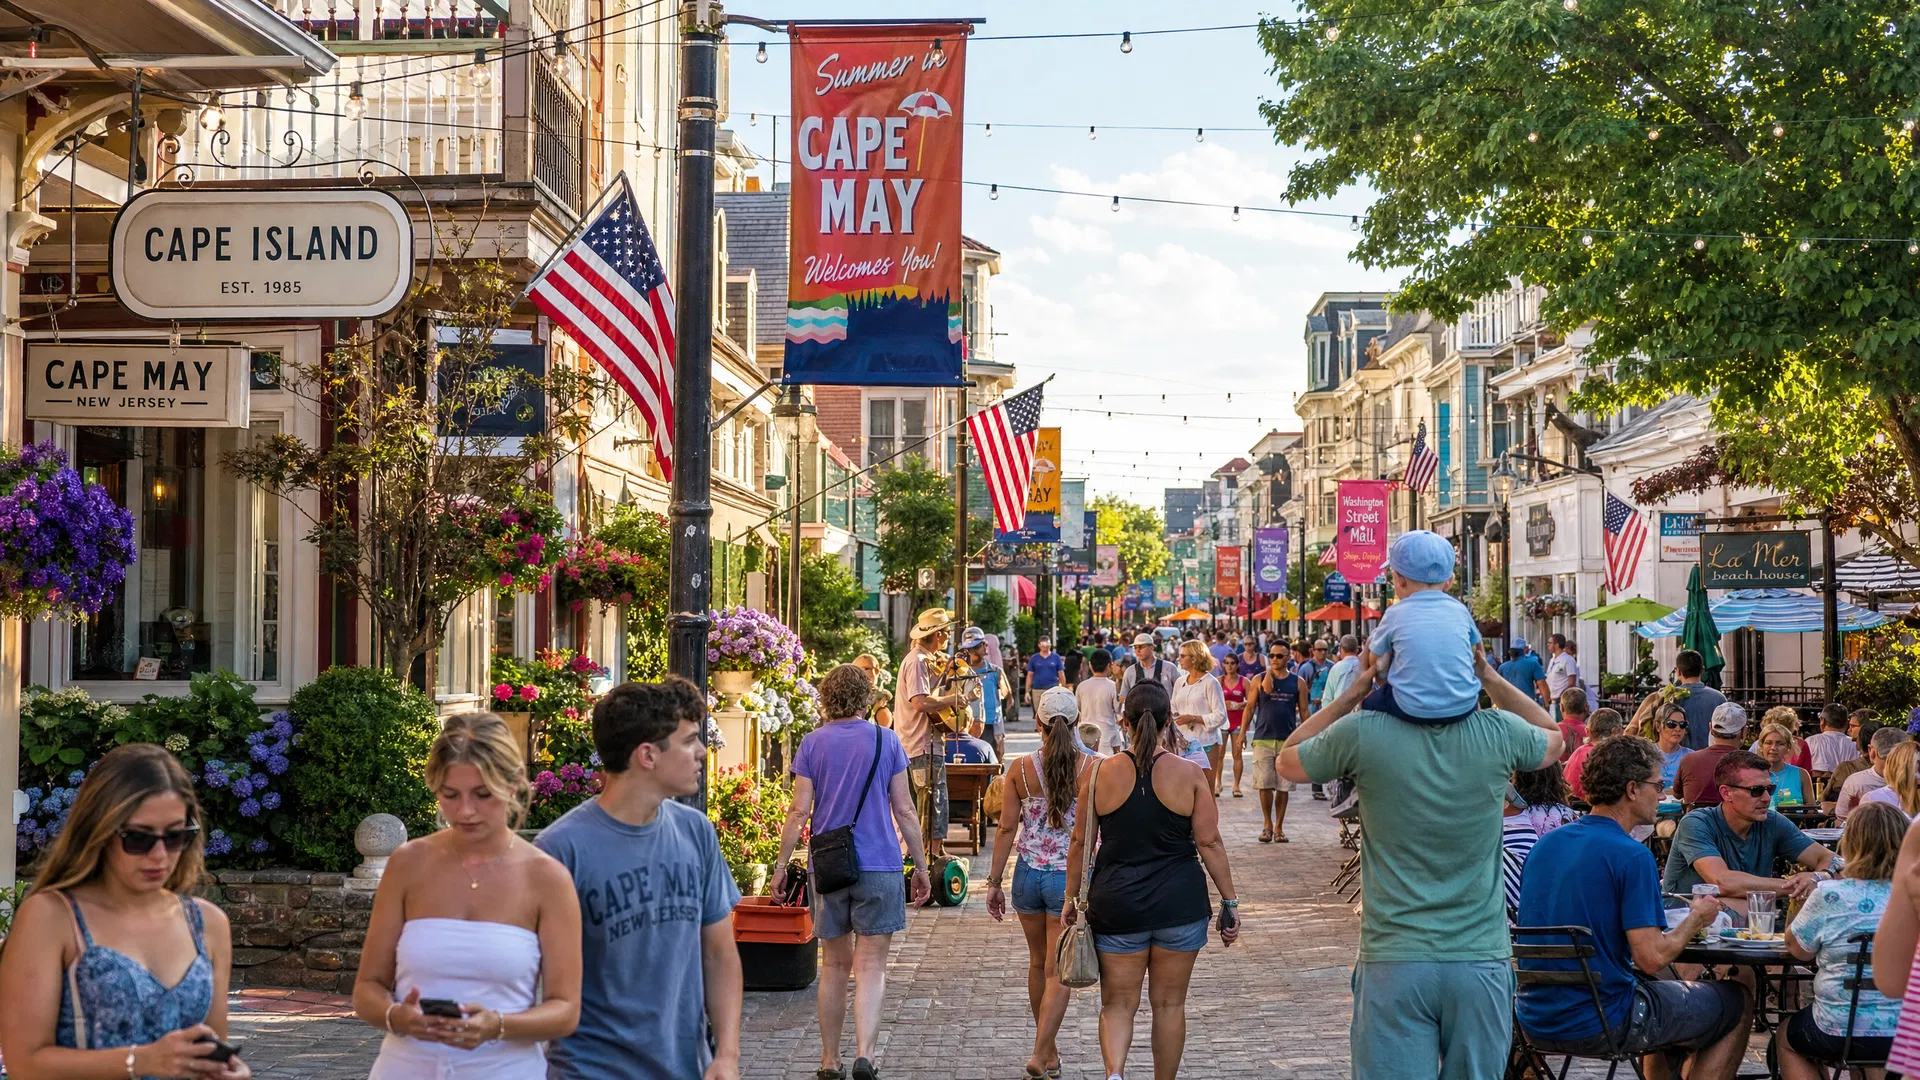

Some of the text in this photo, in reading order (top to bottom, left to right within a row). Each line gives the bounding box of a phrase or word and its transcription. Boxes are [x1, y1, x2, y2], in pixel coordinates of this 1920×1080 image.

[815, 53, 914, 96] Summer
[798, 116, 910, 172] CAPE
[820, 178, 924, 234] MAY
[145, 226, 378, 262] CAPE ISLAND
[804, 242, 941, 285] Welcomes You!
[221, 281, 302, 294] EST. 1985
[45, 359, 213, 391] CAPE MAY
[76, 396, 177, 409] NEW JERSEY
[1342, 496, 1384, 511] Washington
[1346, 510, 1380, 524] Street
[1707, 541, 1804, 569] La Mer
[1712, 570, 1753, 580] beach
[585, 866, 653, 926] CAPE
[608, 912, 645, 943] NEW
